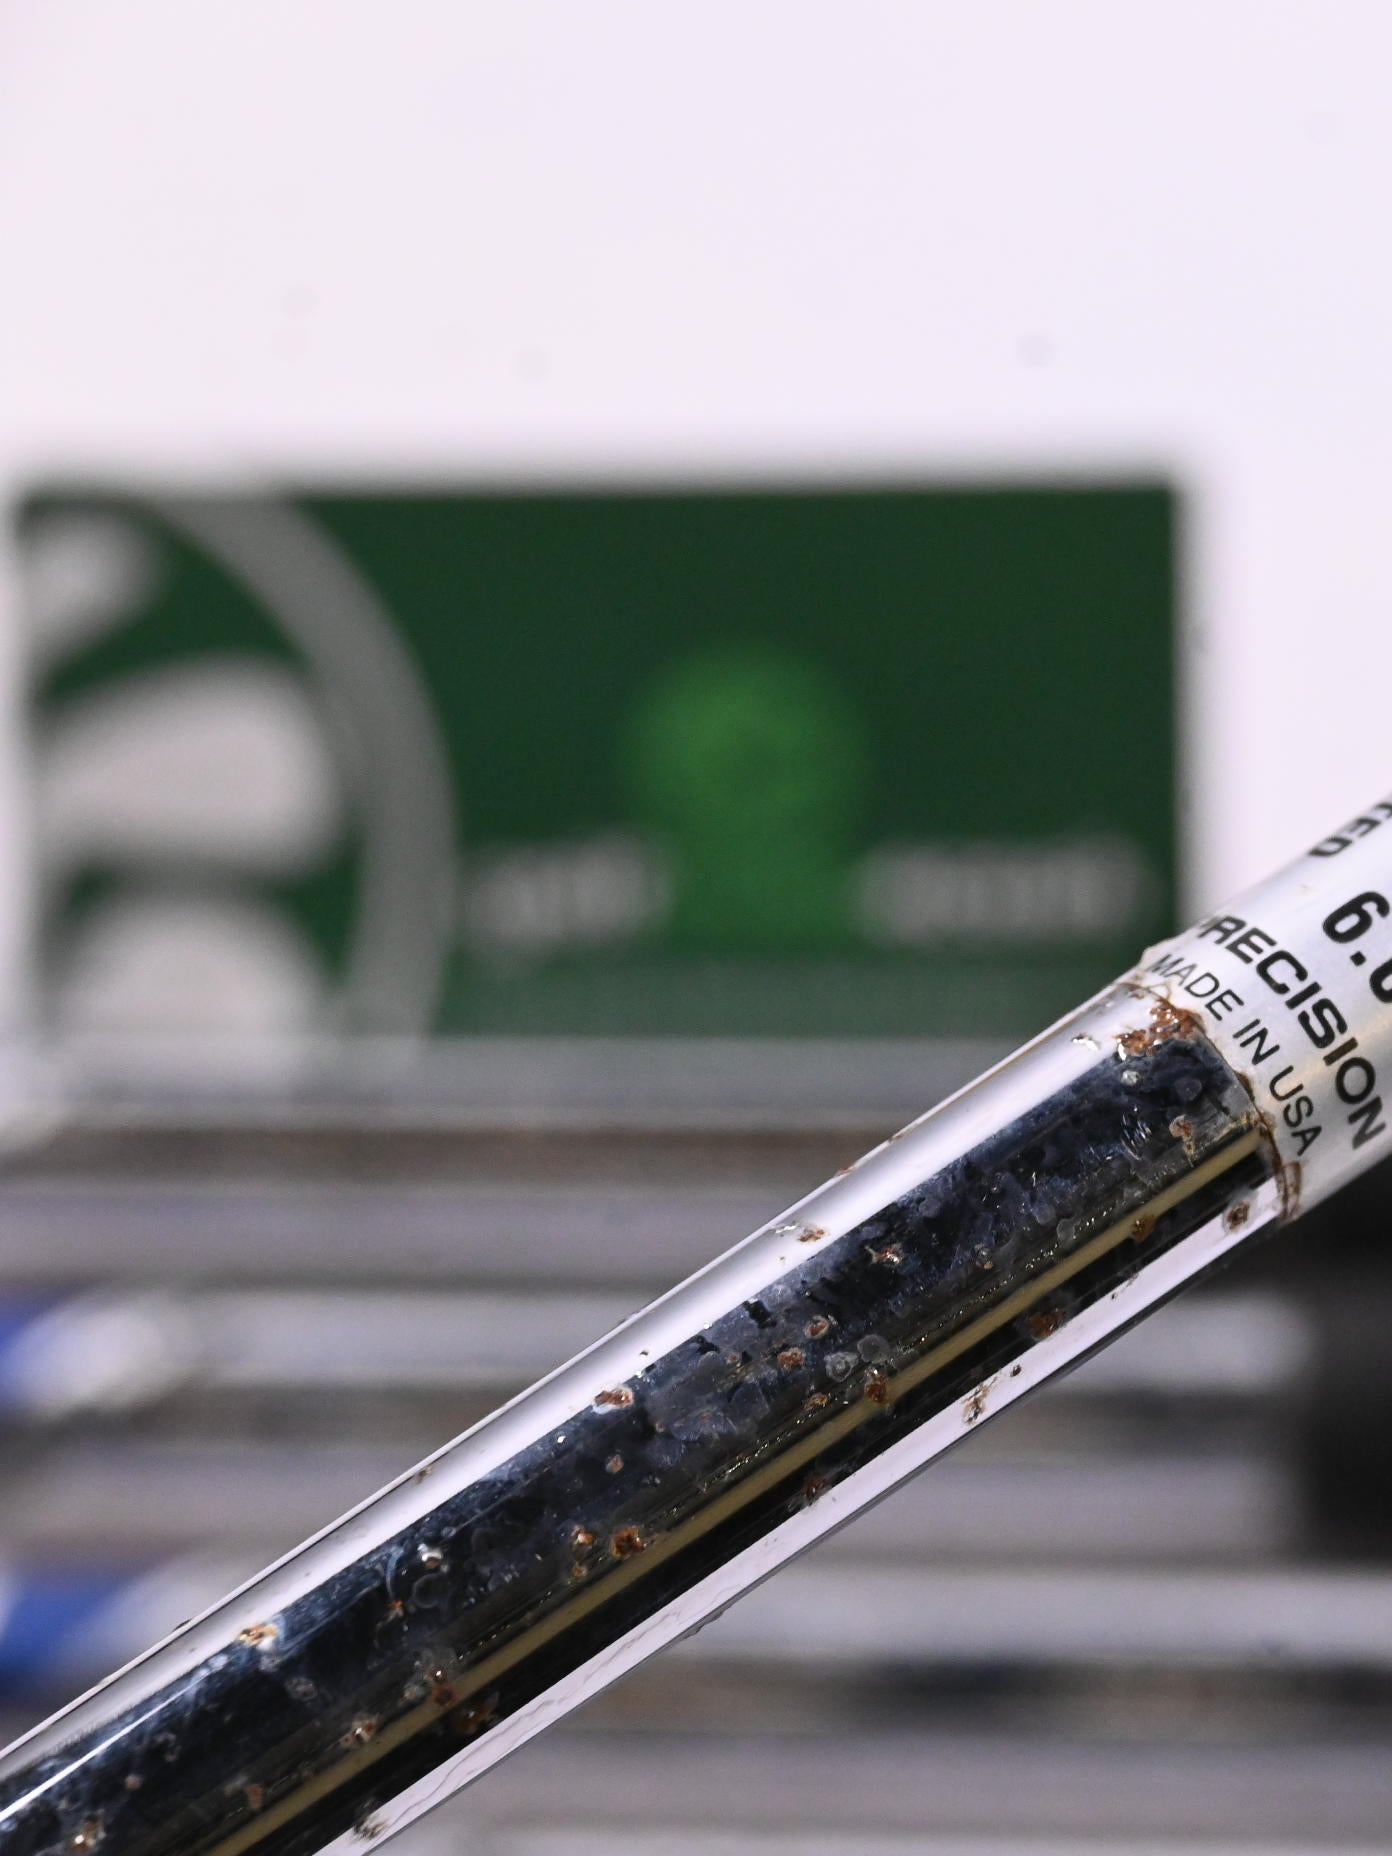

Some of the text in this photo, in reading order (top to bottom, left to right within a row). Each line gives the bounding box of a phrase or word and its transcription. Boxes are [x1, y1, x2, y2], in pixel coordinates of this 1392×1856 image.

[1145, 953, 1324, 1157] MADE IN USA
[1198, 915, 1387, 1150] RECISION
